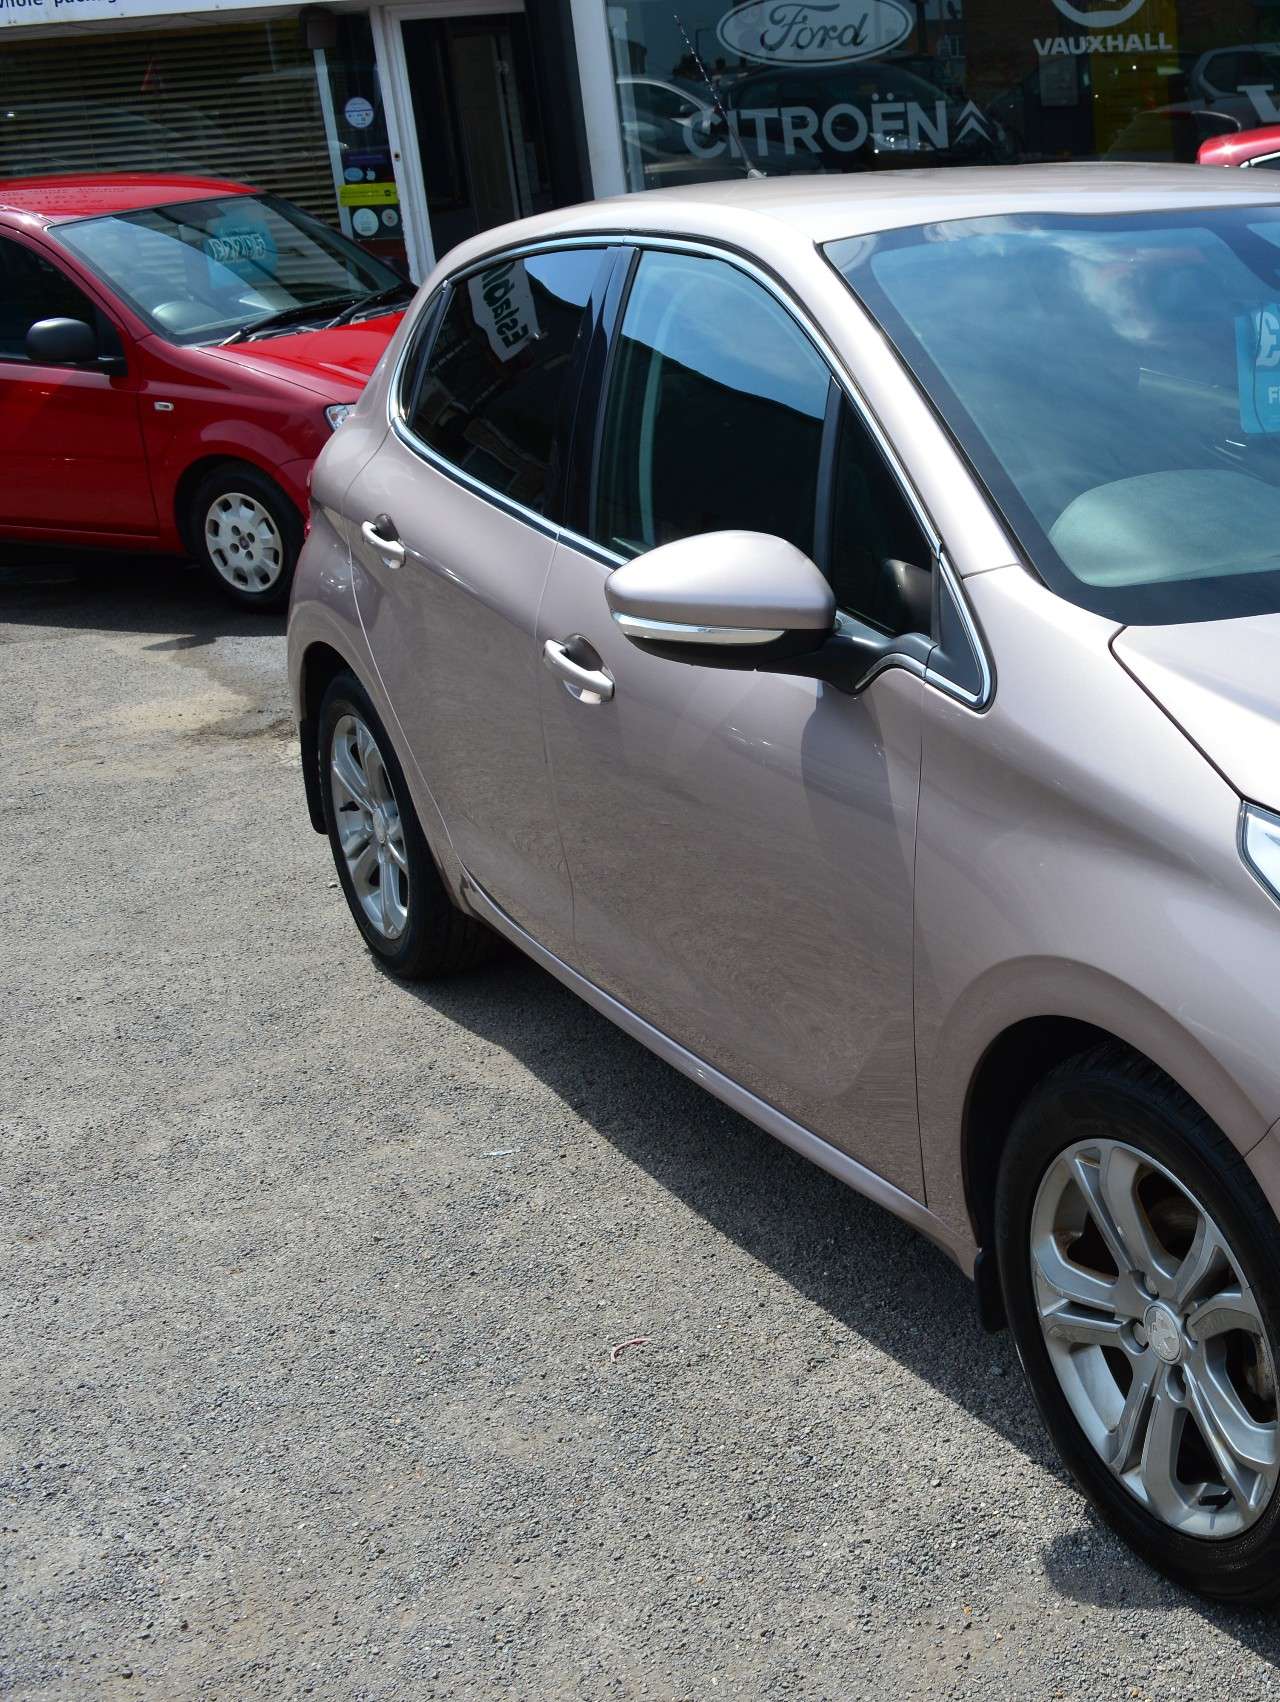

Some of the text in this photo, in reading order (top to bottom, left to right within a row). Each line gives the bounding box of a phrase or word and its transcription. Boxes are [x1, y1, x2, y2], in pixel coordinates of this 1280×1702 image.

[759, 3, 869, 51] Ford
[1032, 32, 1173, 56] VAUXHALL
[682, 93, 948, 159] CITROËN
